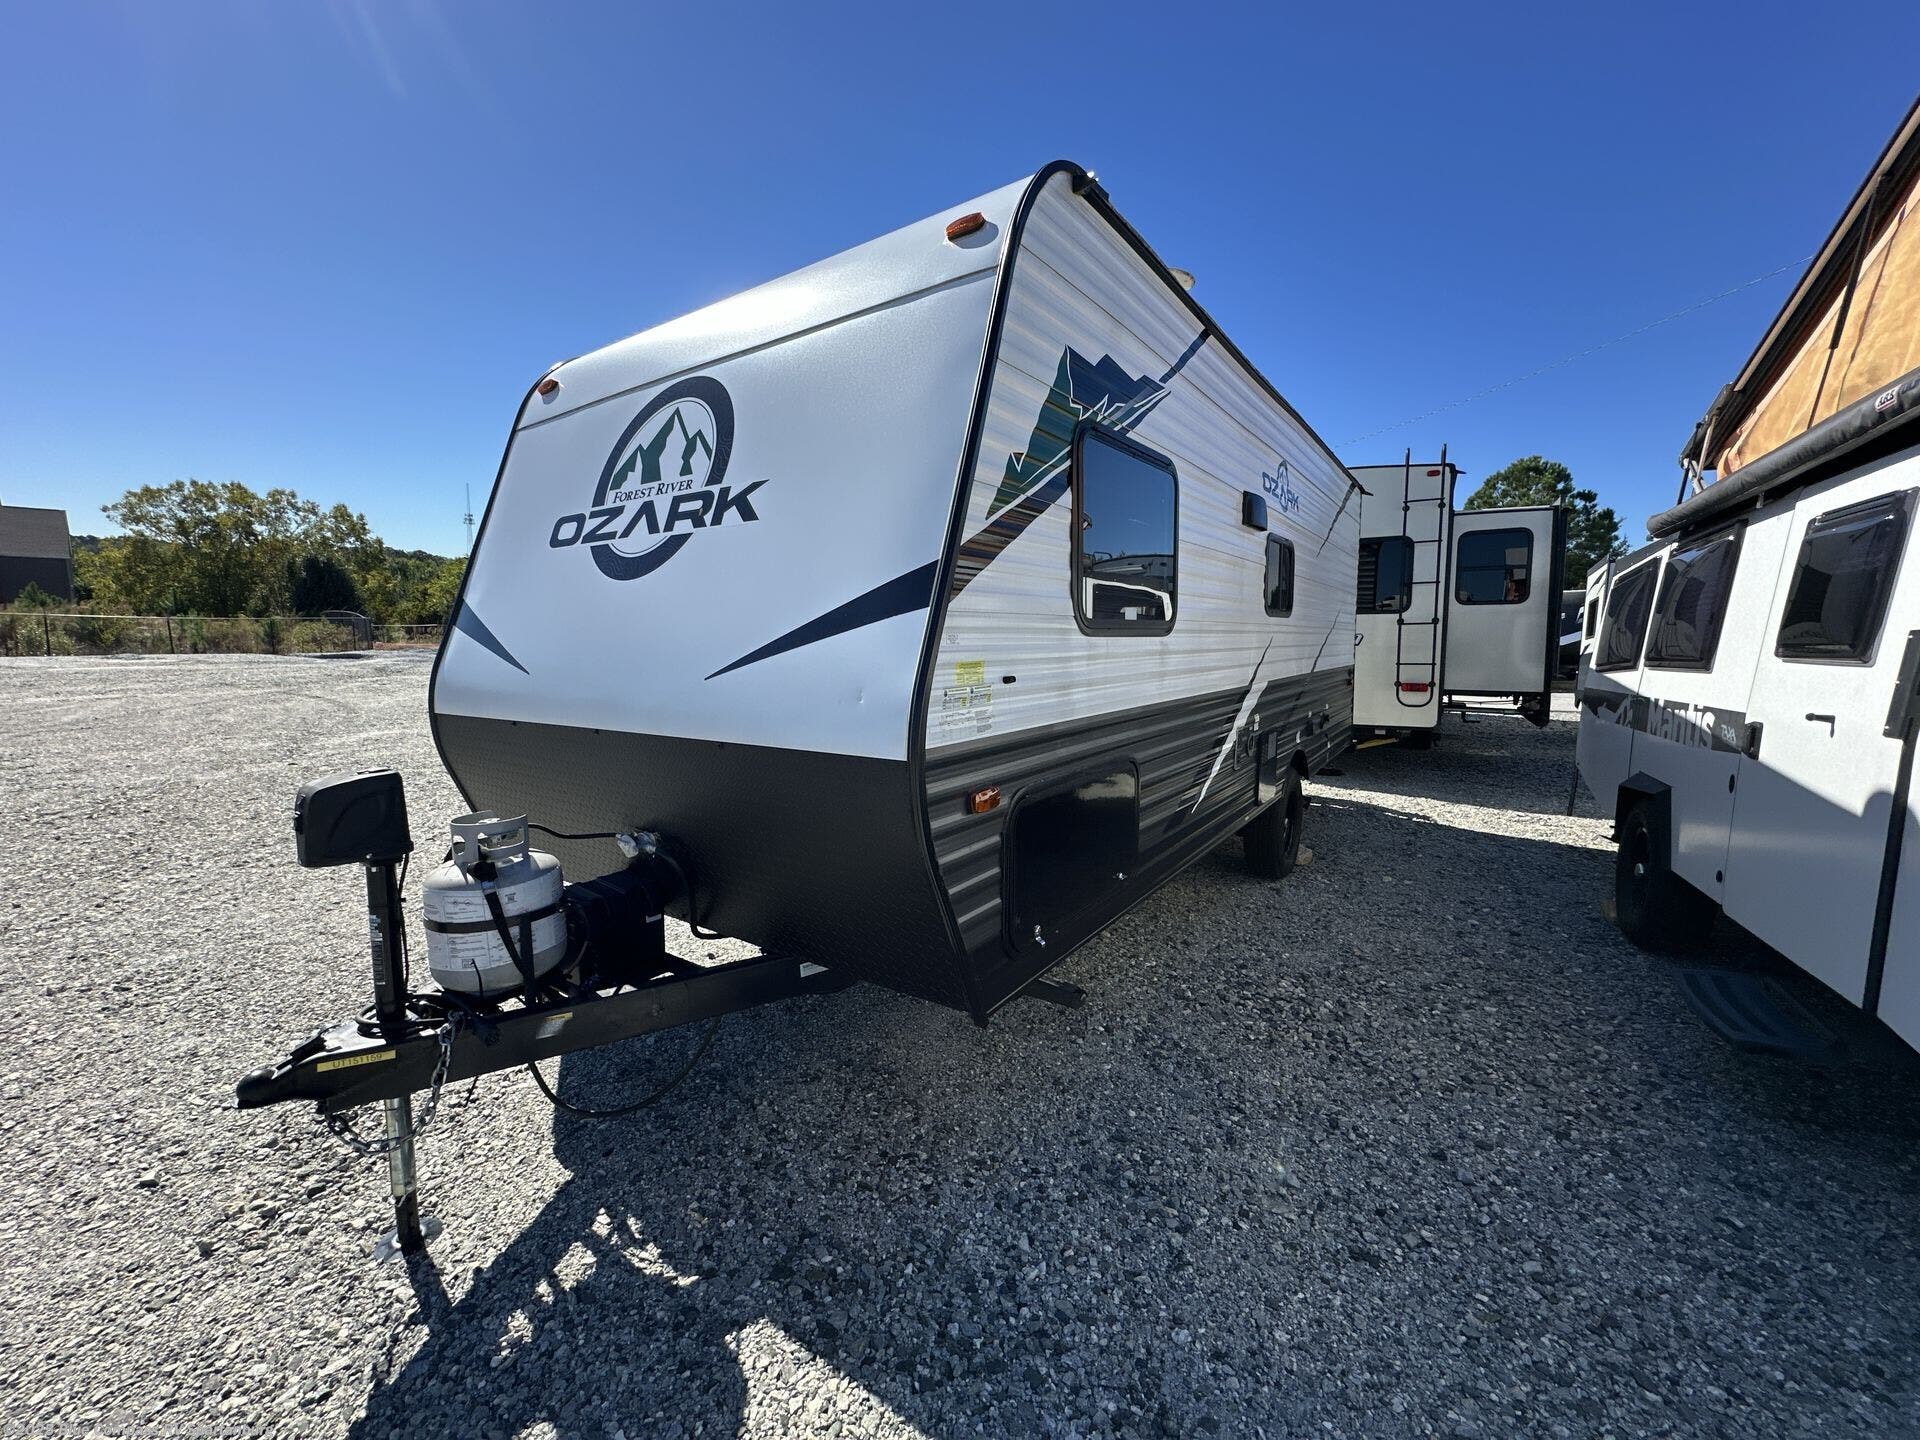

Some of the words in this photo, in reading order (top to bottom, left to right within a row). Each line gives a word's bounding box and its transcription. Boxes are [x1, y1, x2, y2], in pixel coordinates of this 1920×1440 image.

[549, 478, 770, 549] OZARK
[613, 486, 655, 503] FOREST
[656, 479, 693, 495] RIVER
[1262, 471, 1299, 513] OZARK
[1646, 696, 1716, 751] Mantis
